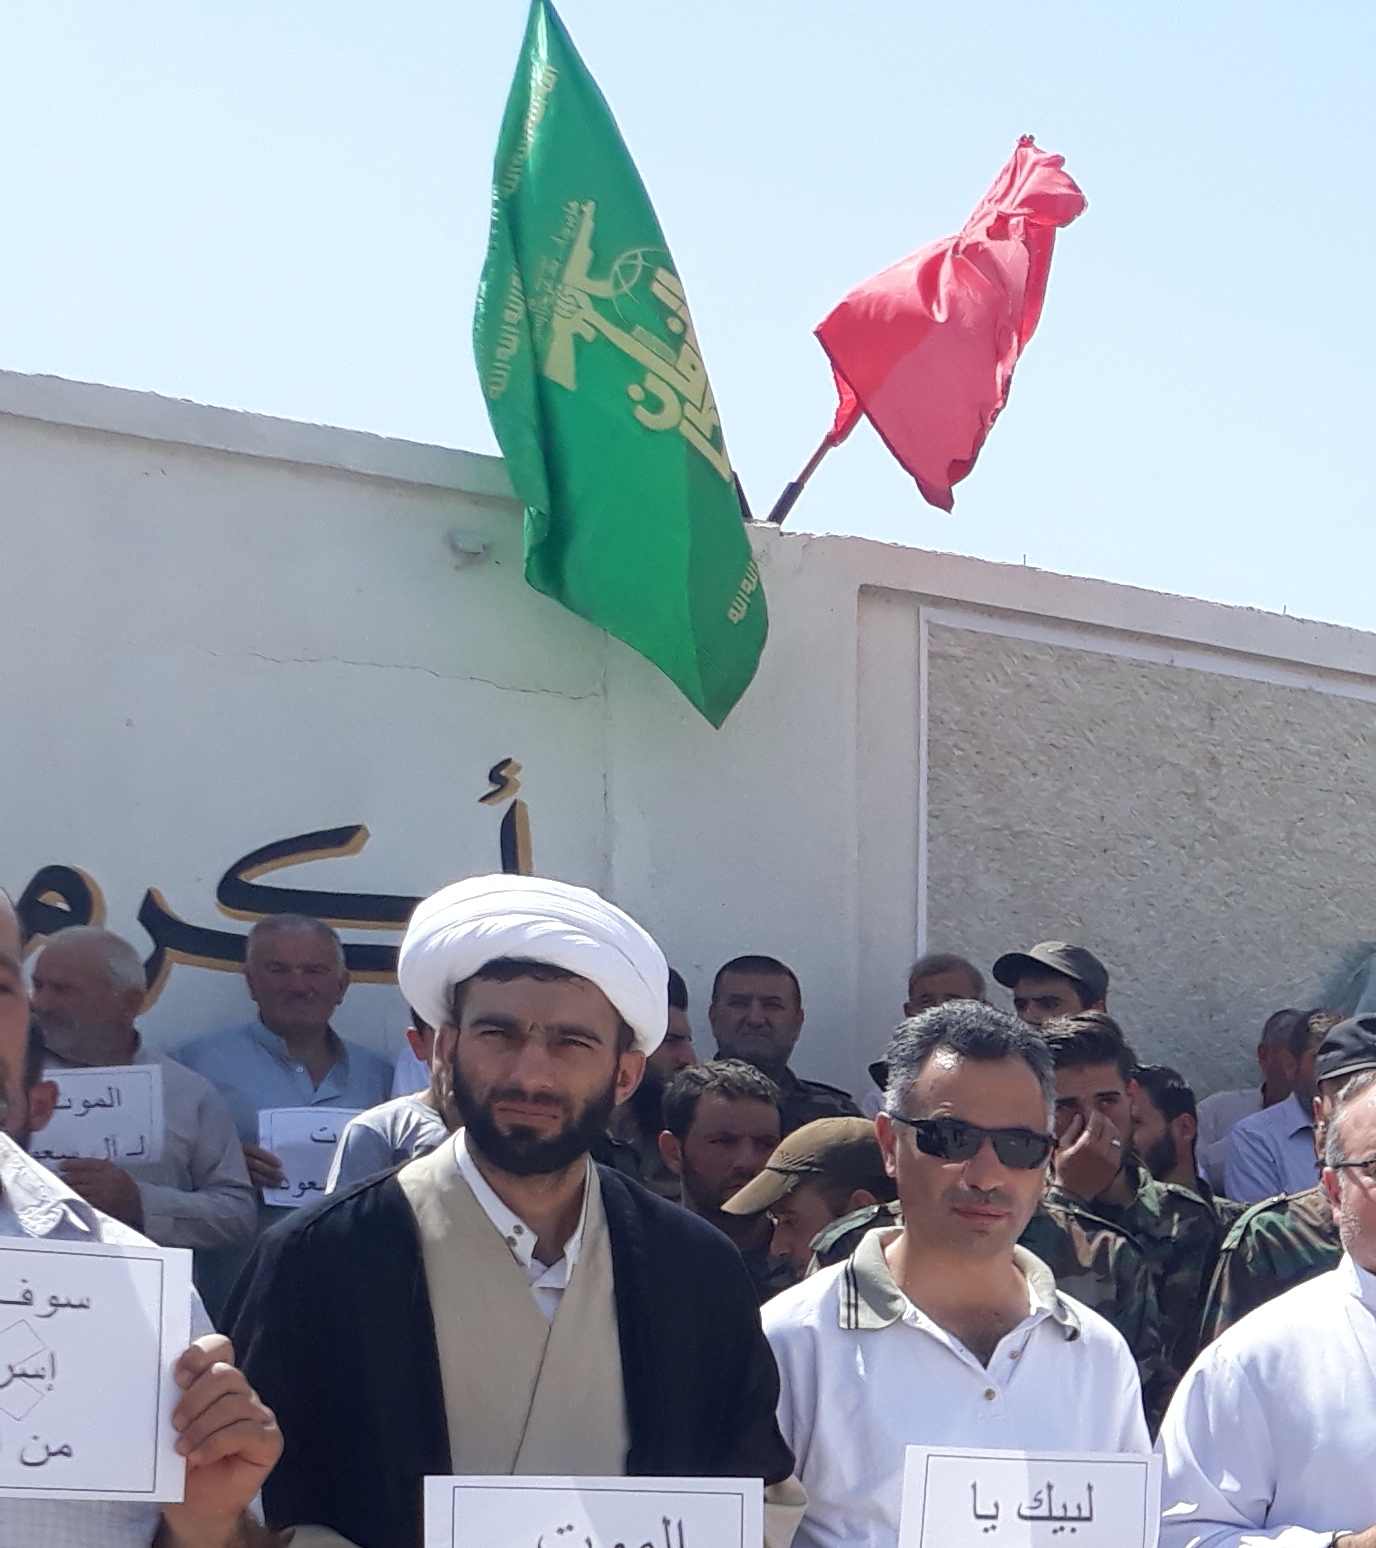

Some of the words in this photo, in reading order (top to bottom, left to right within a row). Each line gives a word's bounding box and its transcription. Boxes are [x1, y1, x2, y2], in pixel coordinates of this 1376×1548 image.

[20, 1434, 73, 1467] من
[970, 1481, 999, 1534] يا
[1016, 1480, 1094, 1535] لبيك
